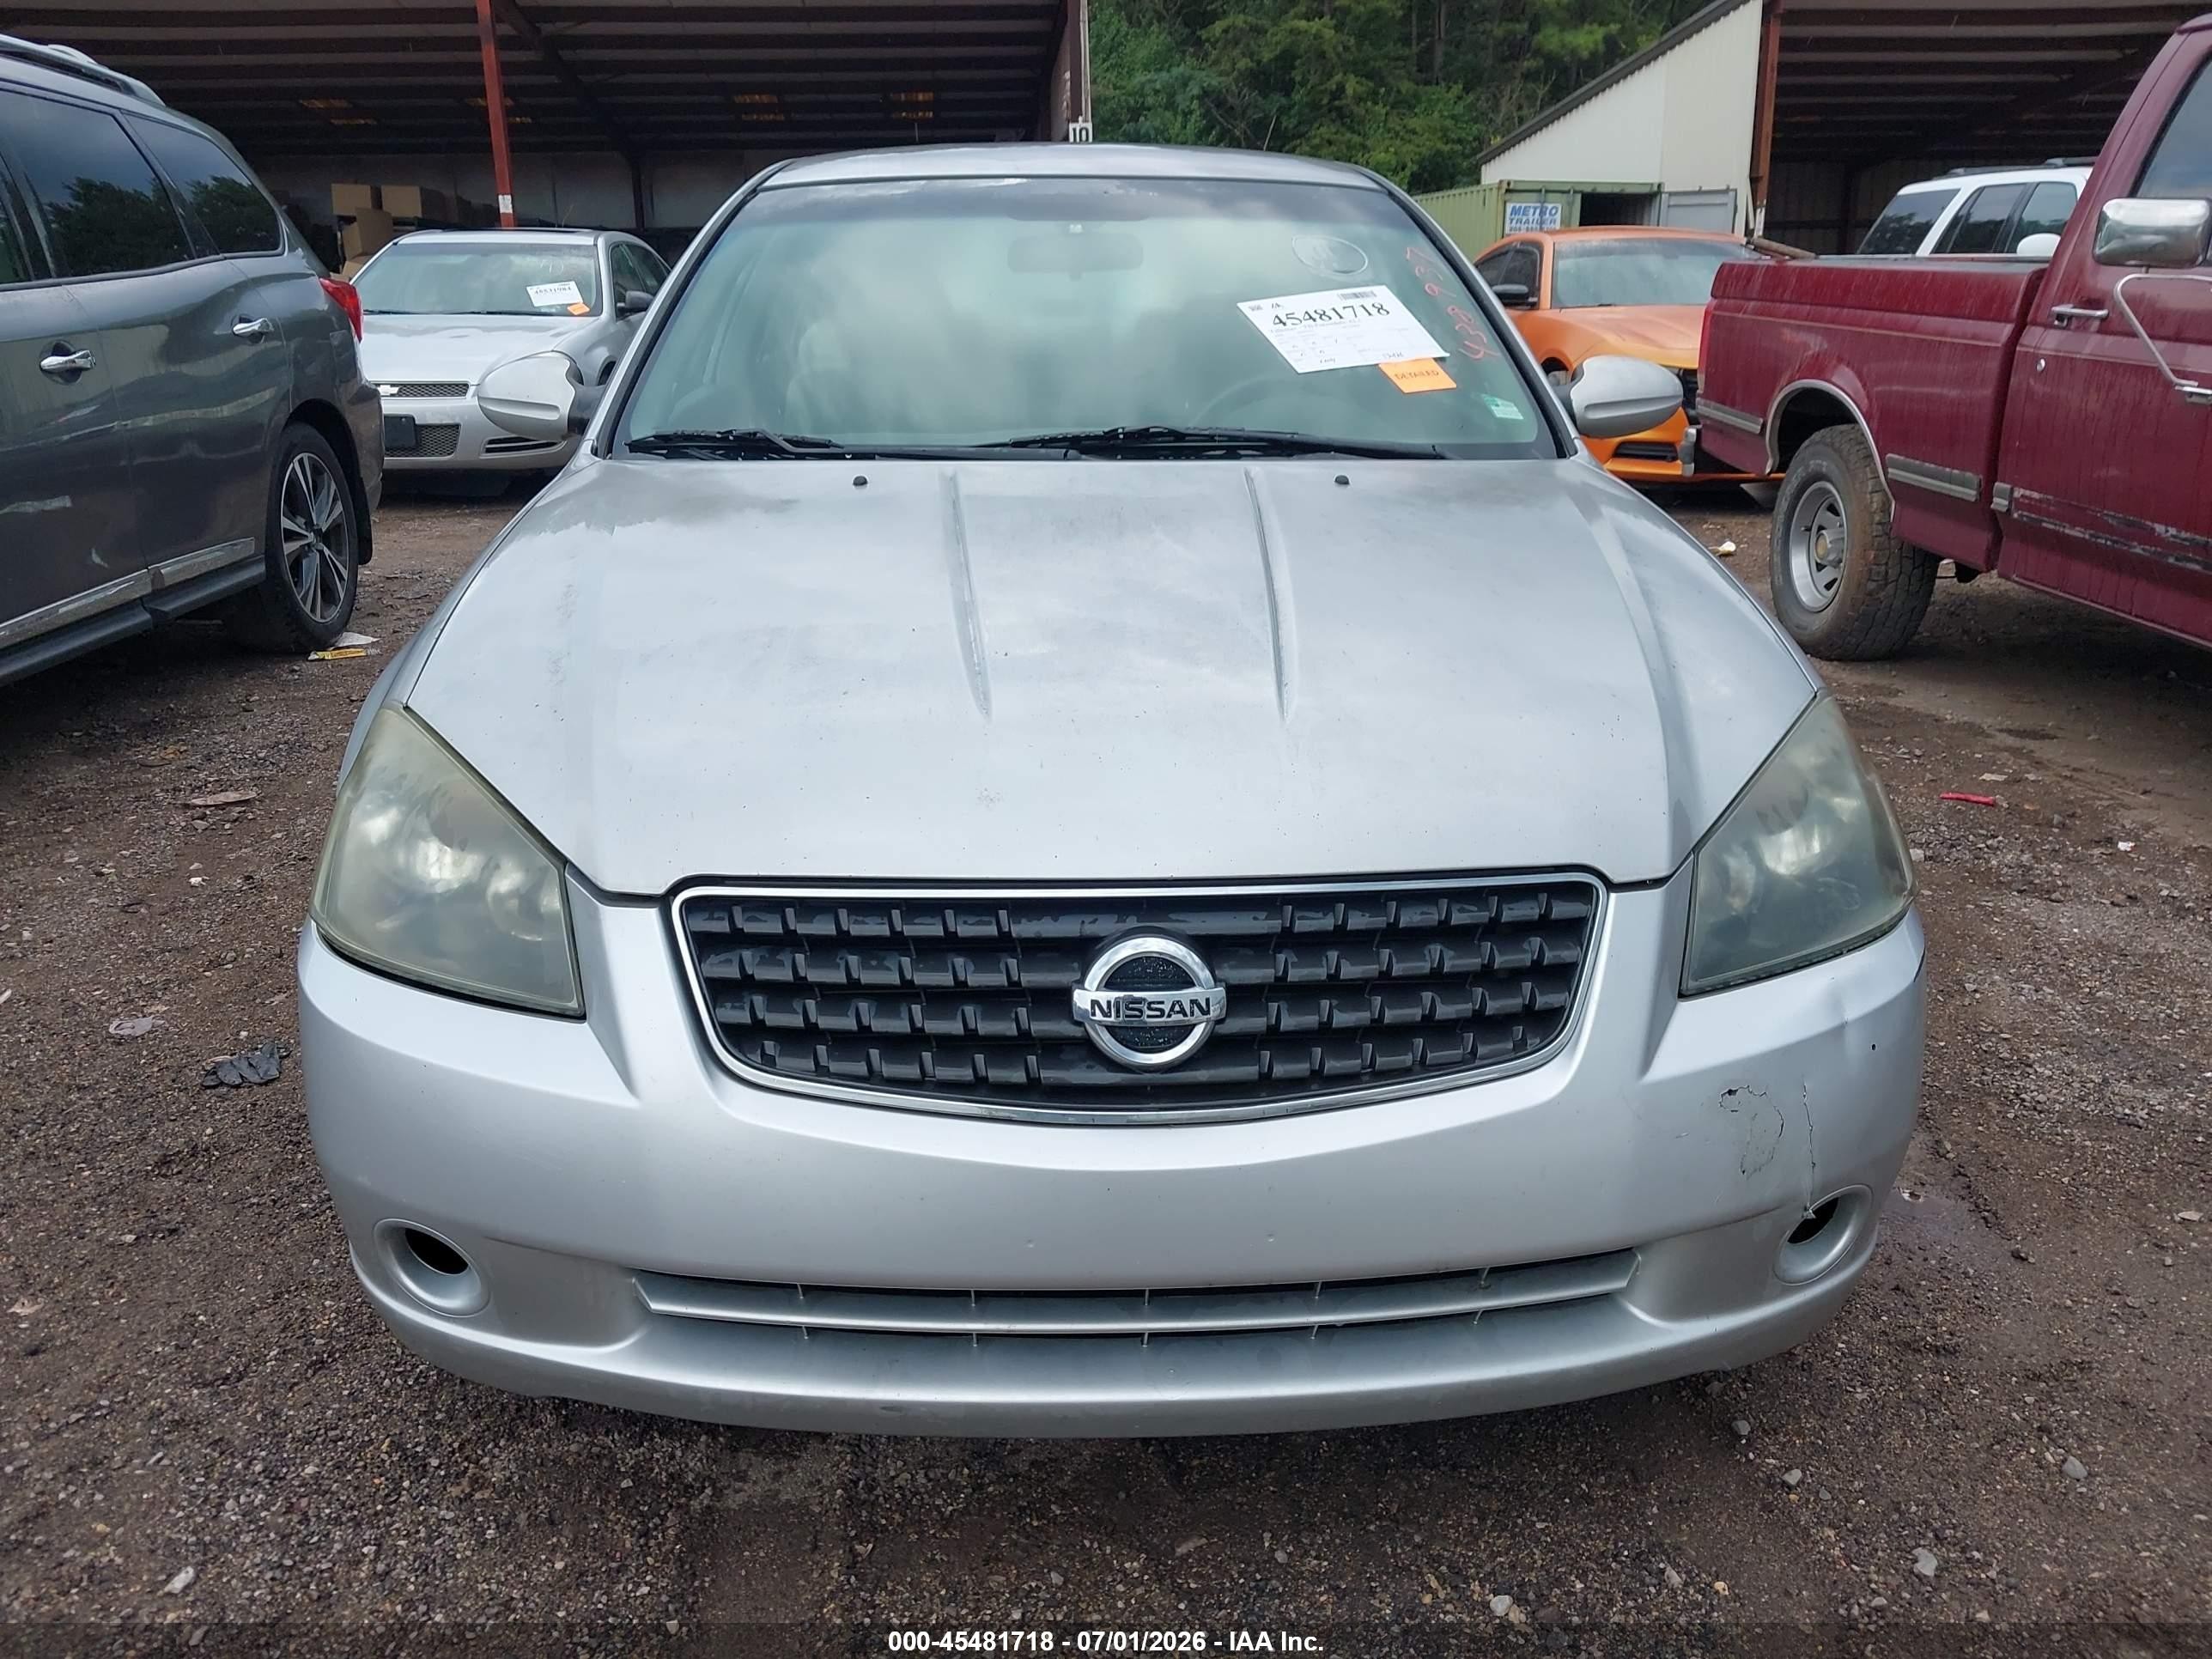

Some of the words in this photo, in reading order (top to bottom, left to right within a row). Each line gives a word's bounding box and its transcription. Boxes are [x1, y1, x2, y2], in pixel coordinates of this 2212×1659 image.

[1510, 205, 1559, 217] METRO
[1273, 302, 1390, 326] 45481718
[1394, 369, 1439, 380] DETAILED
[1090, 997, 1211, 1018] NISSAN
